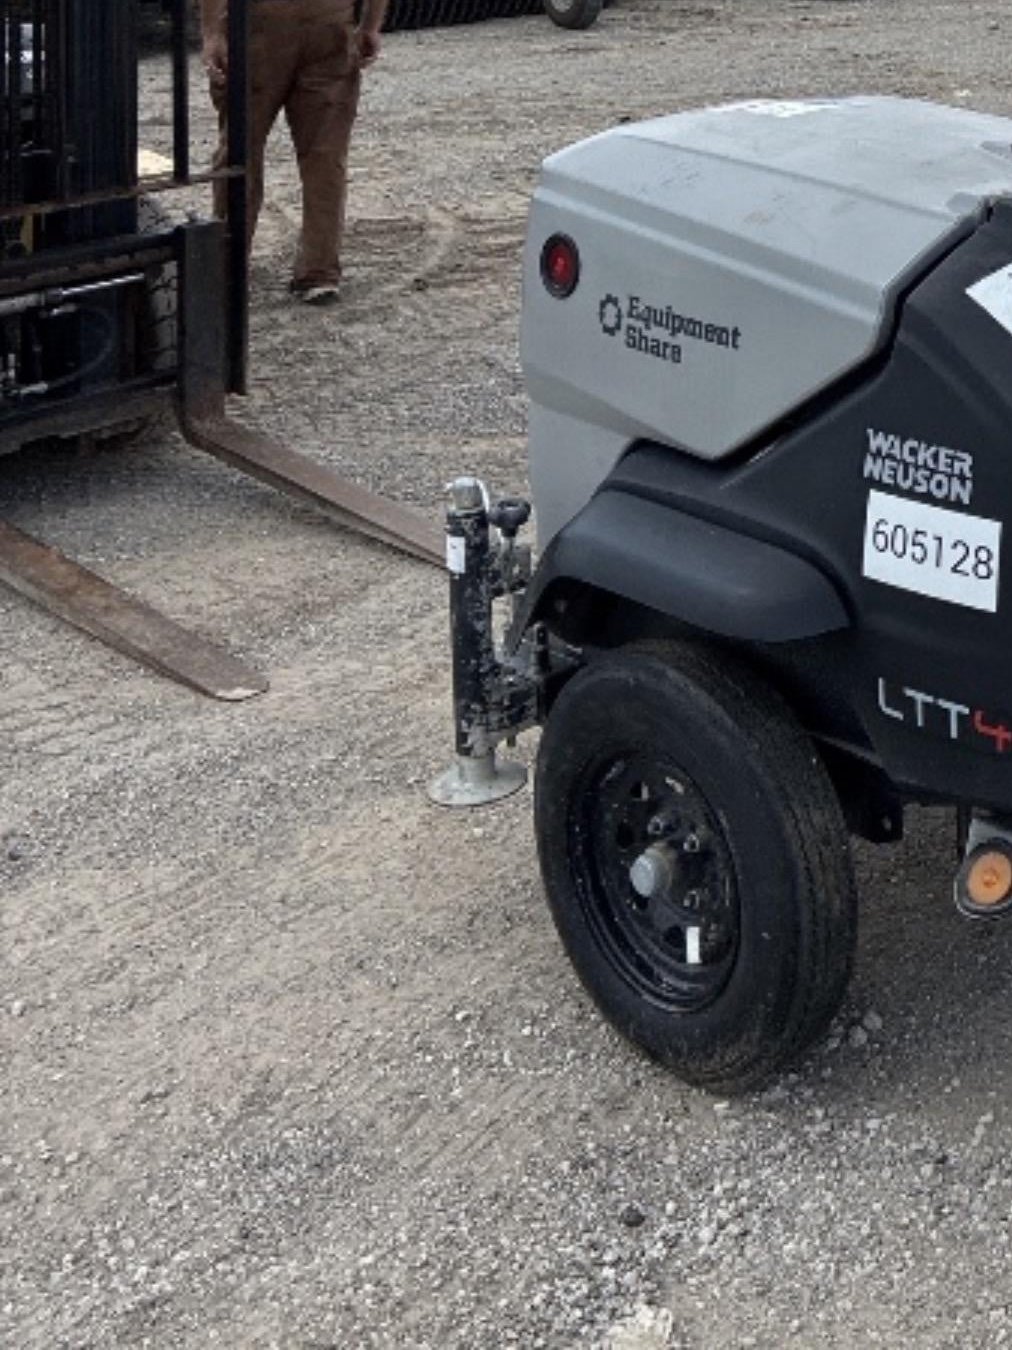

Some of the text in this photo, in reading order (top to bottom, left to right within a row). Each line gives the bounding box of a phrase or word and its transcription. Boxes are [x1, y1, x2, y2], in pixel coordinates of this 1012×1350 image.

[624, 323, 684, 364] Share
[626, 295, 742, 351] Equipment
[863, 452, 973, 505] NEUSON
[866, 427, 973, 478] WACKER
[871, 517, 995, 581] 605128
